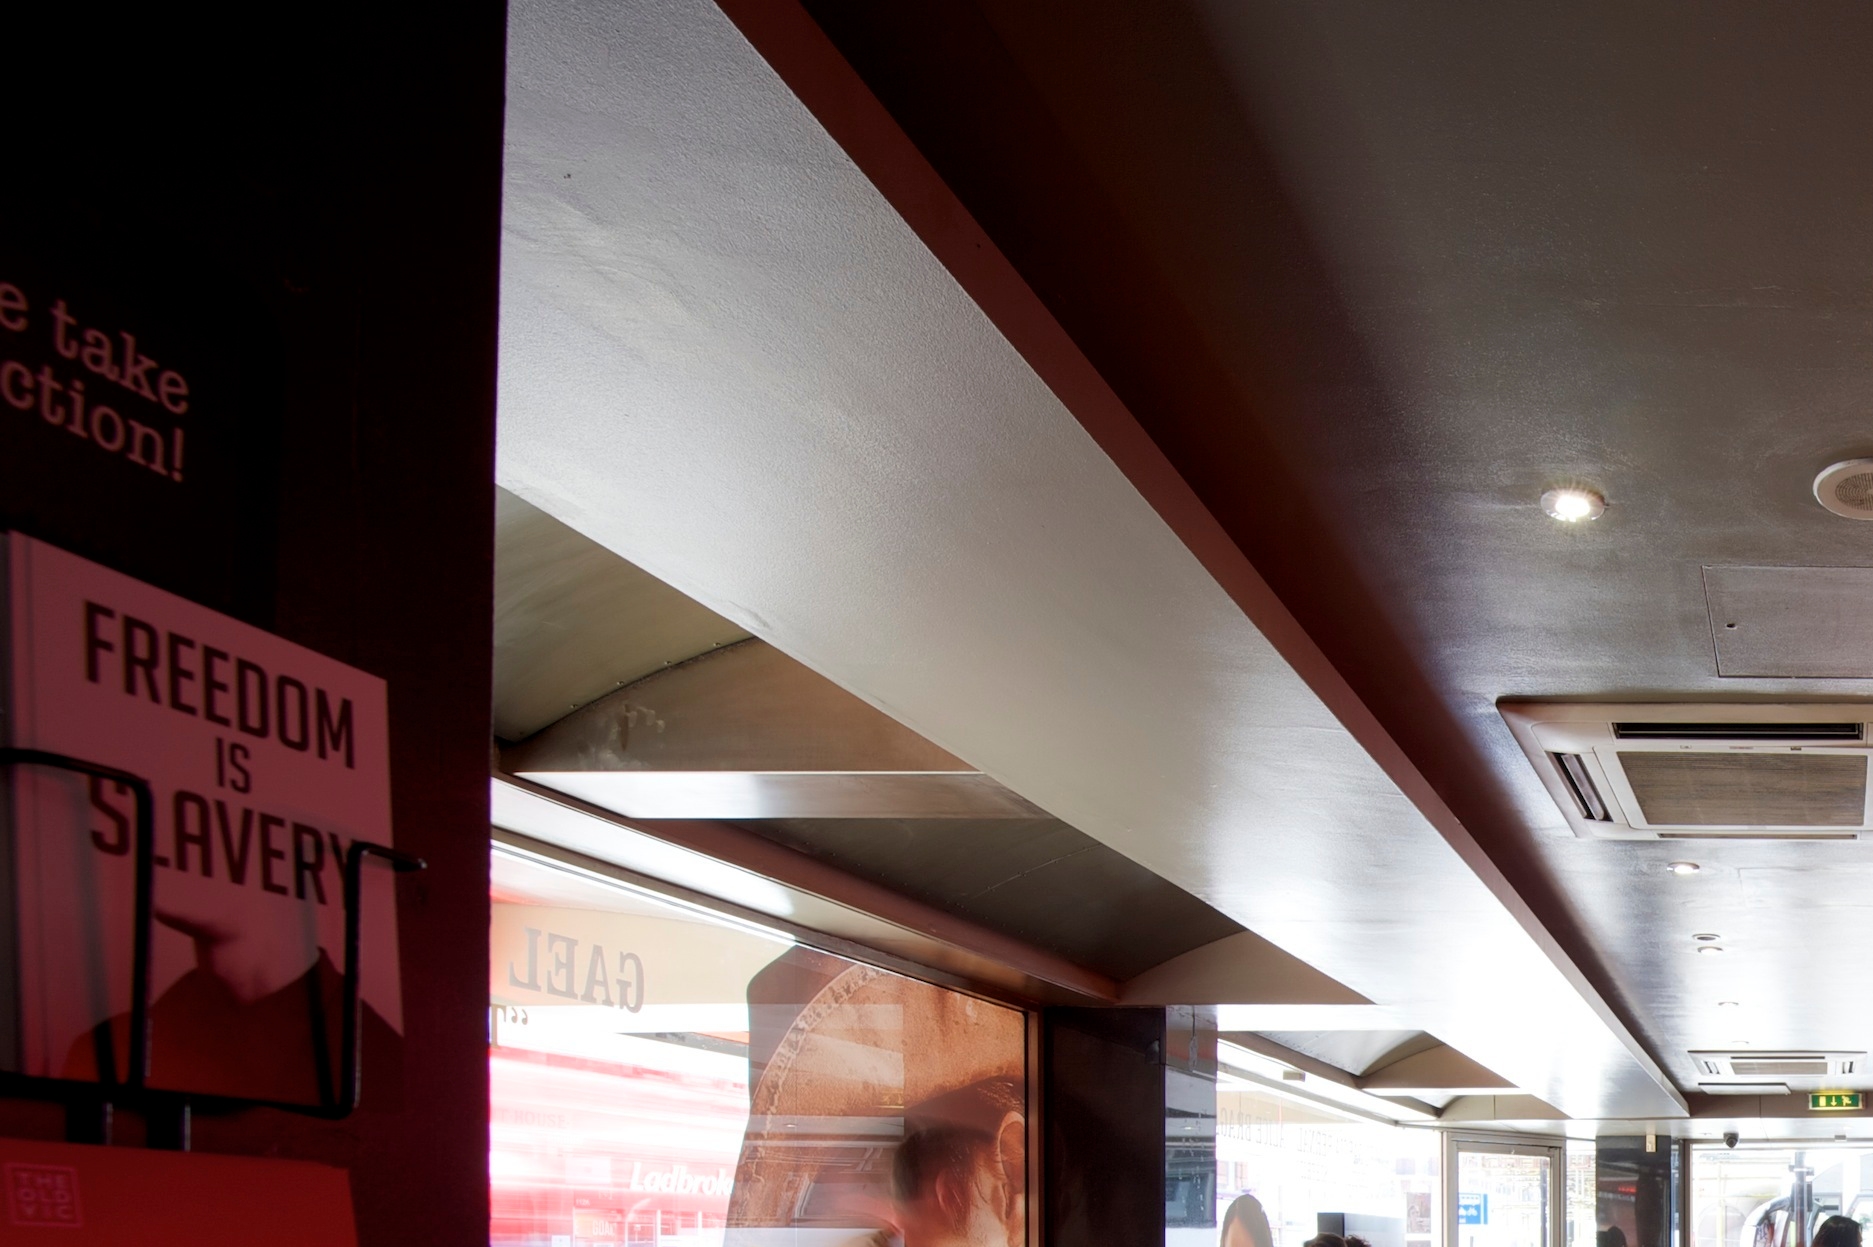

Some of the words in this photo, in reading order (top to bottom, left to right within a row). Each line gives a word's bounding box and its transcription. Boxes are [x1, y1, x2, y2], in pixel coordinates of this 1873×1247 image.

[50, 299, 190, 415] take
[0, 359, 185, 484] ction!
[86, 600, 355, 771] FREEDOM
[216, 737, 252, 795] IS
[90, 774, 354, 912] SAVERY
[16, 1172, 67, 1189] THE
